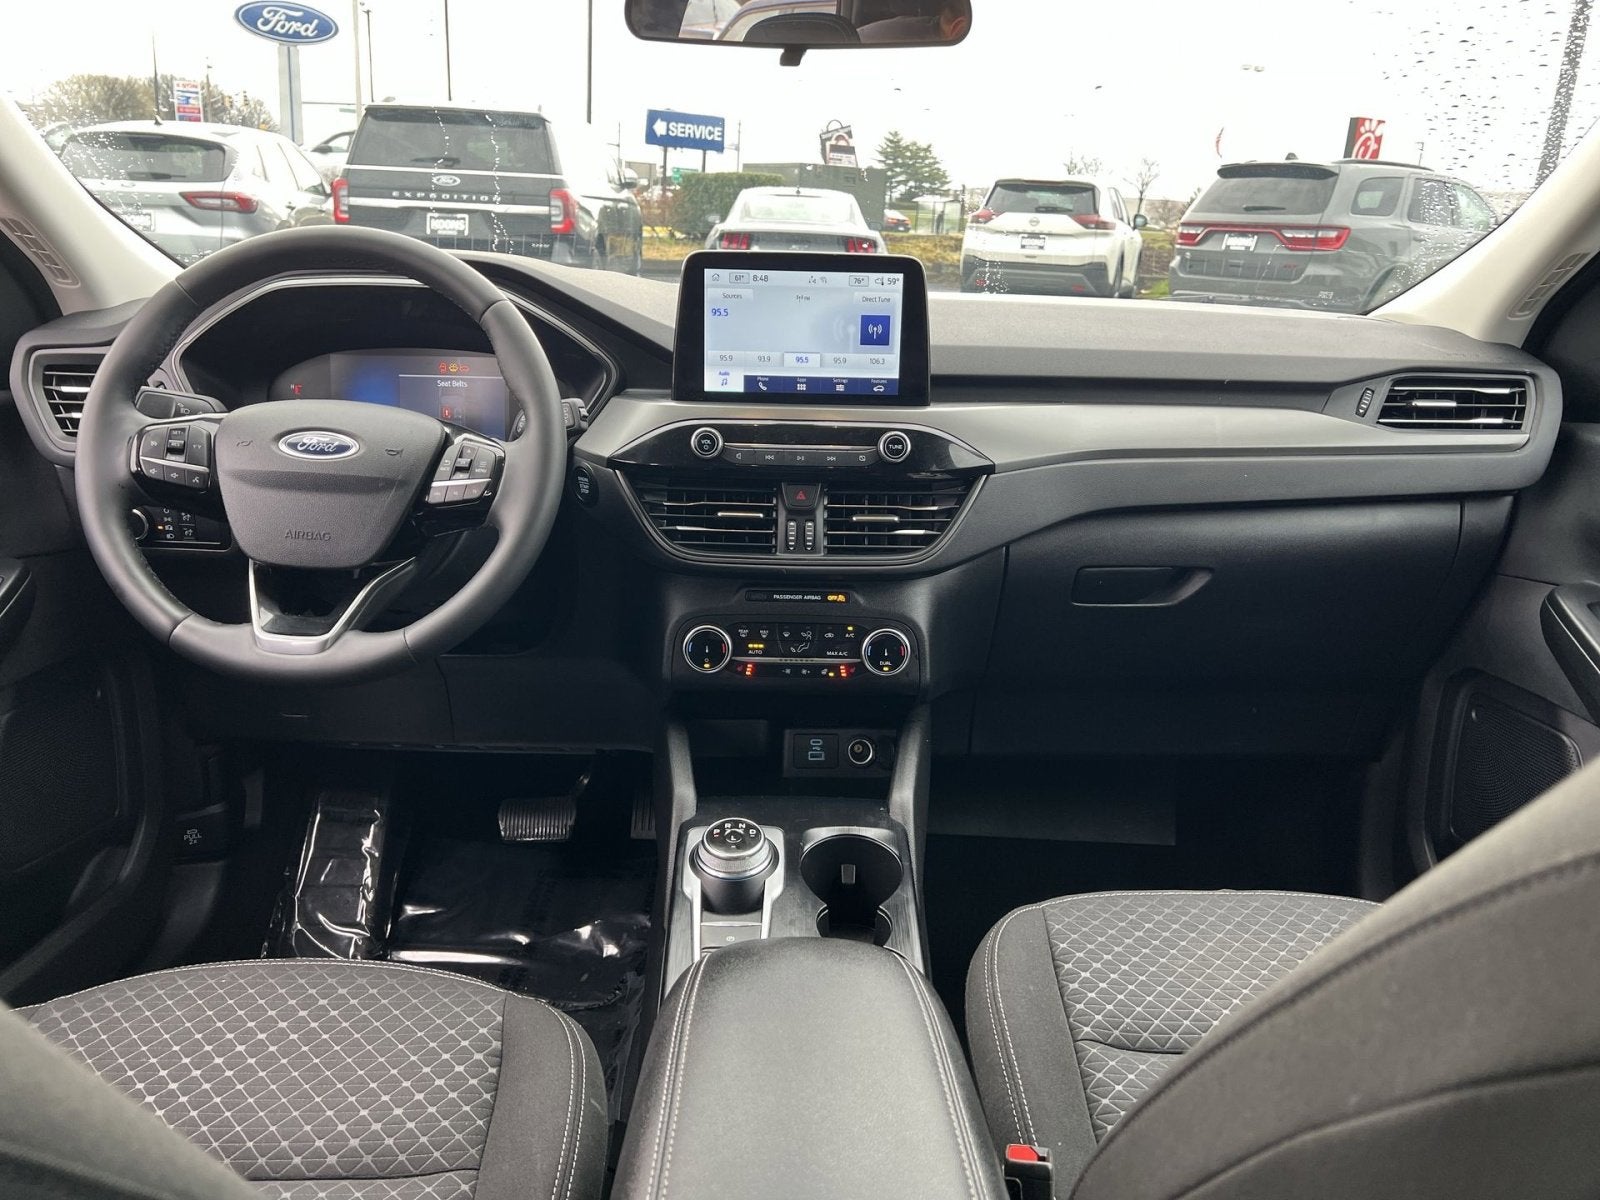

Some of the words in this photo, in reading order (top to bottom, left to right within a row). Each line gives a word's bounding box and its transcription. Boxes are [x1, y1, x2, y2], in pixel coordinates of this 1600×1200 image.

[257, 6, 319, 37] Ford
[668, 121, 723, 141] SERVICE
[752, 275, 769, 283] 8:48
[722, 292, 743, 300] Sources
[862, 295, 877, 303] Direct
[711, 308, 729, 317] 95.5
[719, 354, 734, 362] 95.9
[795, 356, 809, 364] 95.5
[869, 358, 886, 366] 106.3
[437, 379, 451, 388] Seat
[452, 380, 468, 388] Belts
[297, 436, 339, 452] Ford
[284, 529, 332, 542] AIRBAG
